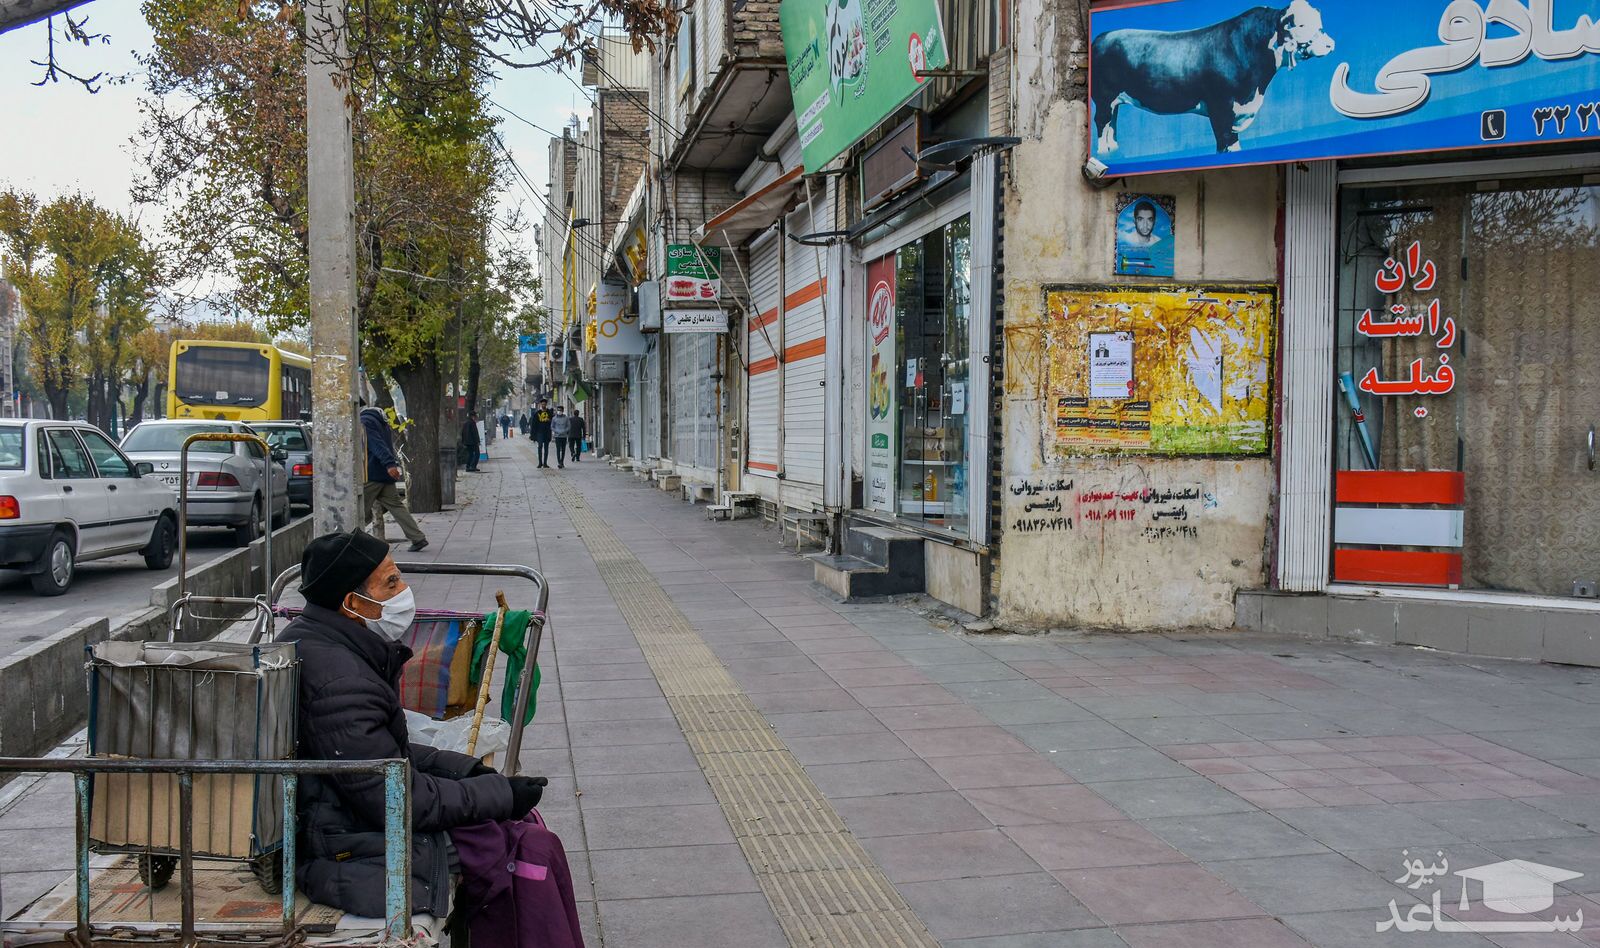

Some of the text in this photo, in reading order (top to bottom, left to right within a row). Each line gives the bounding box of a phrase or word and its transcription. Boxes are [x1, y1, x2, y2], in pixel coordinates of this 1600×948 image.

[1532, 104, 1570, 136] ۳۲
[693, 247, 719, 258] دندن
[1375, 240, 1437, 293] ران
[1356, 298, 1456, 348] راسته
[1359, 353, 1456, 418] فیله
